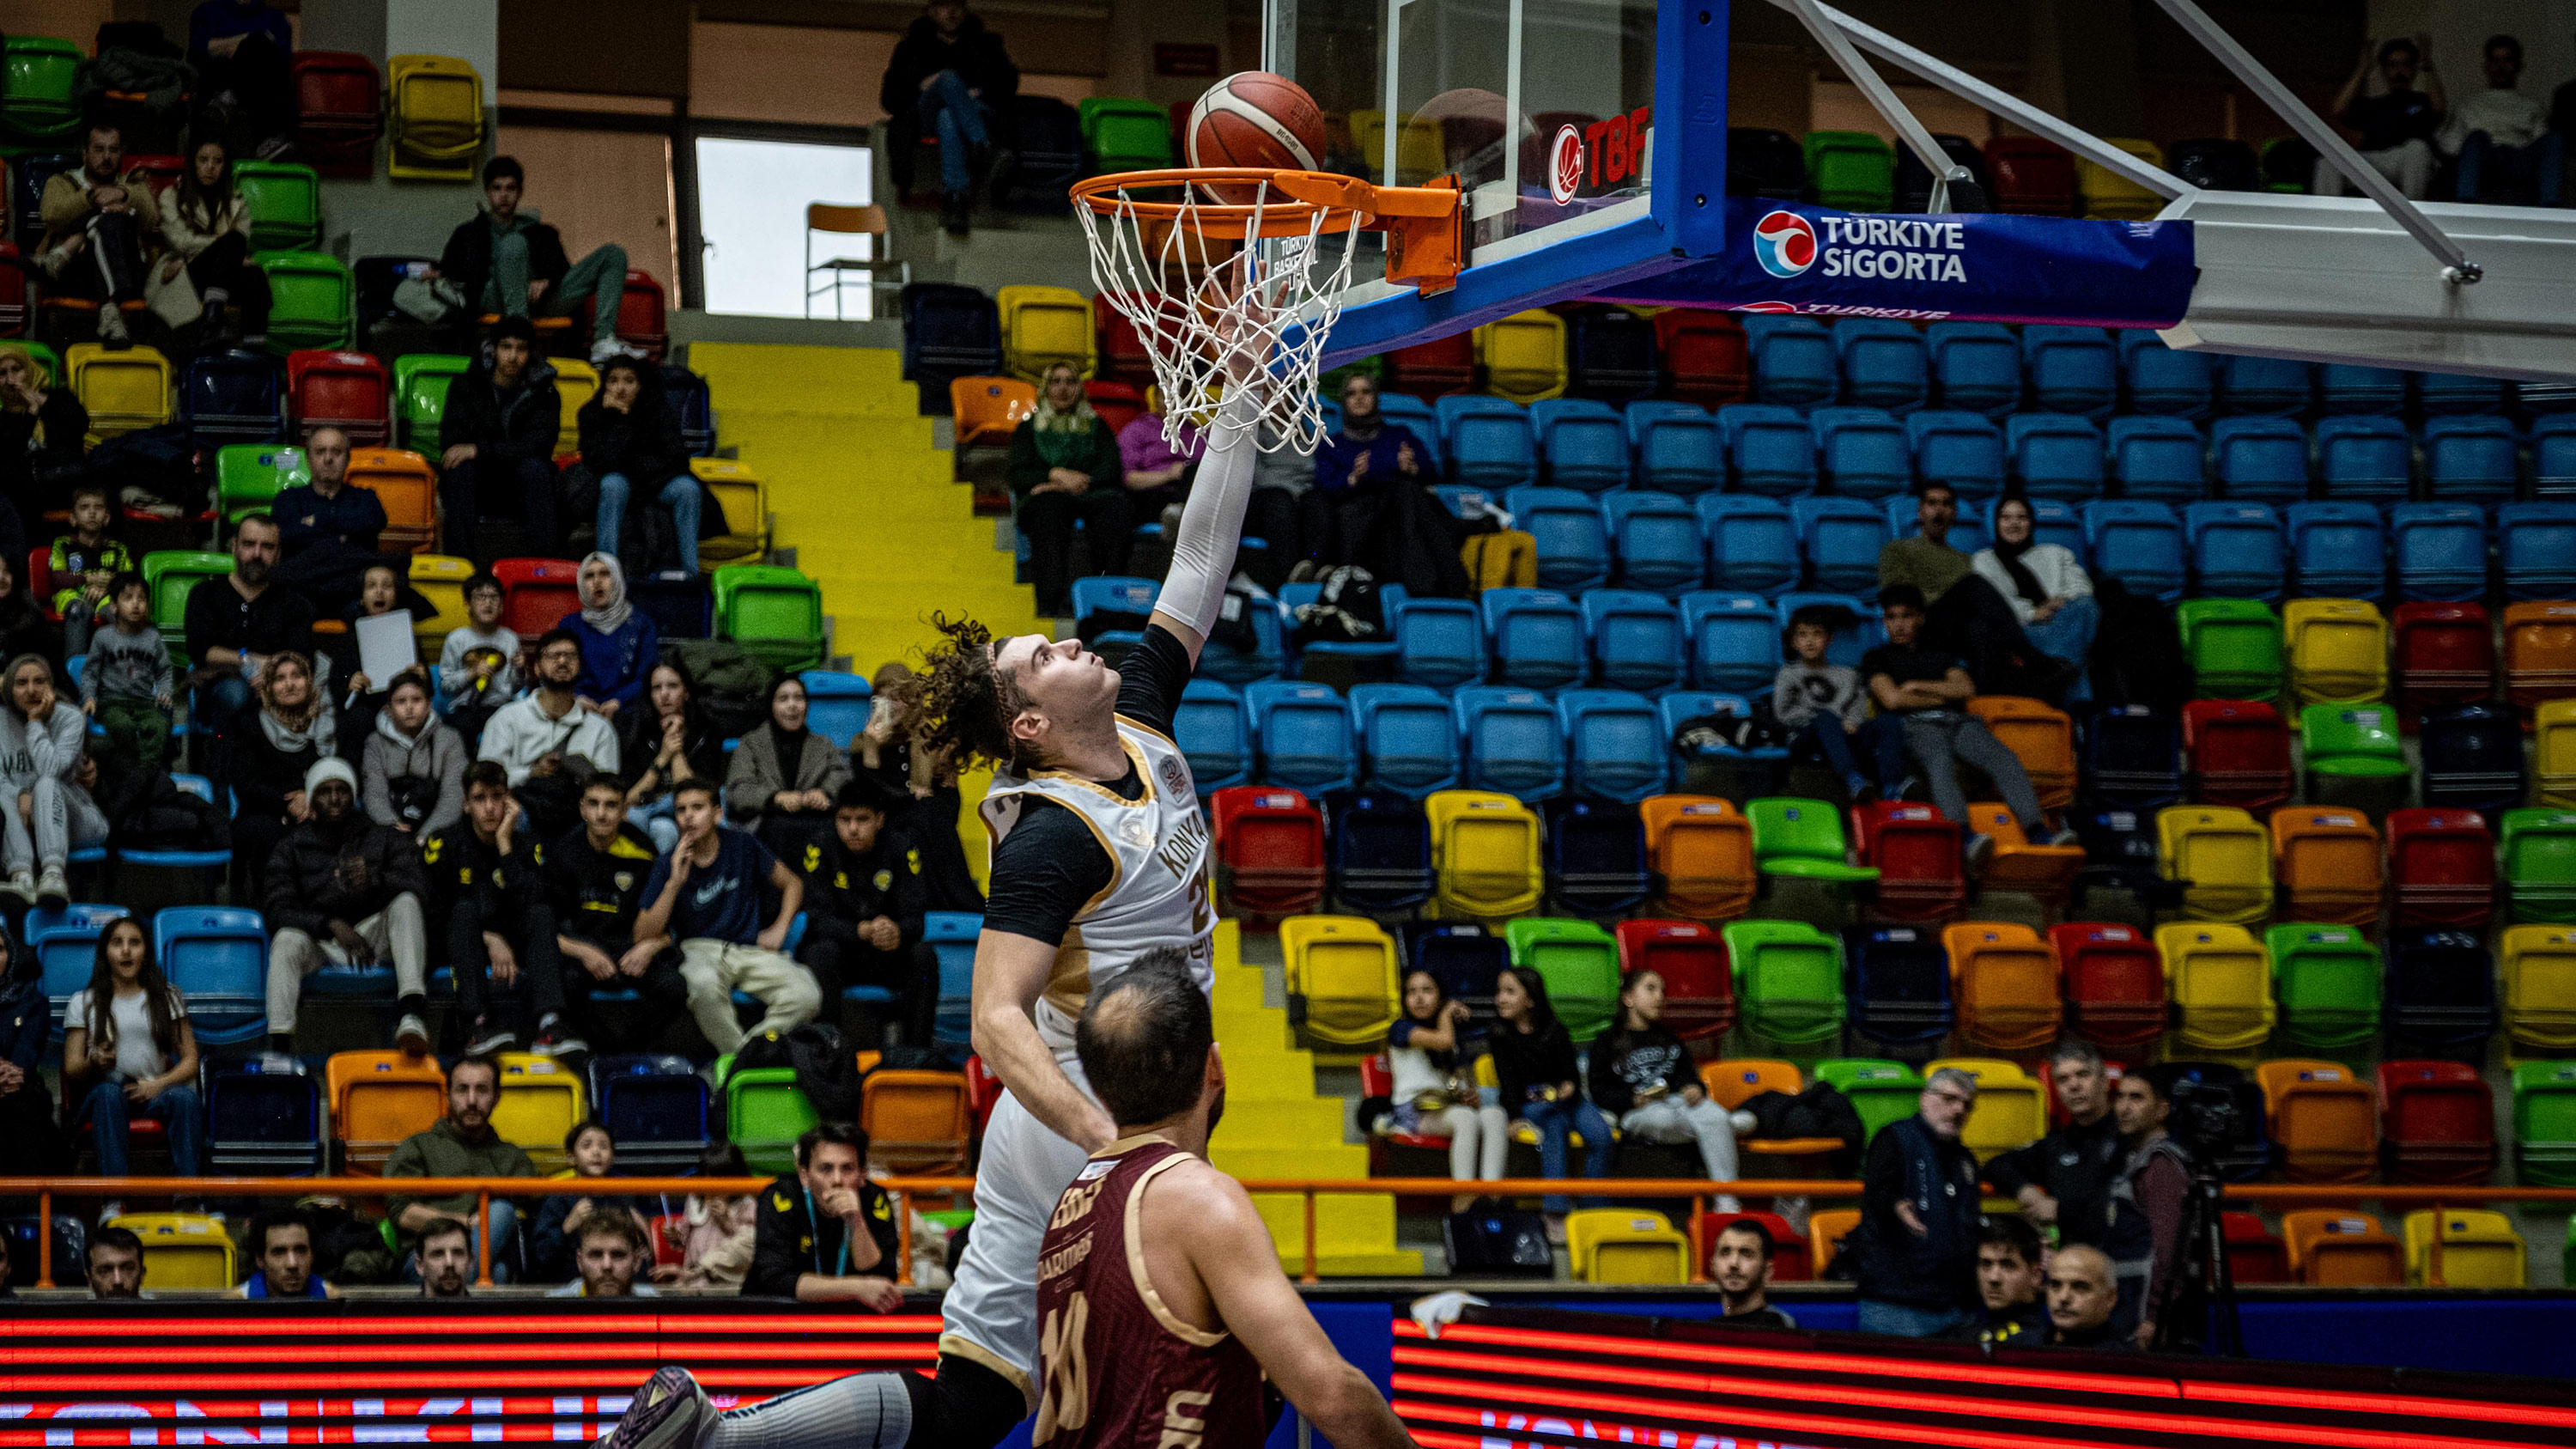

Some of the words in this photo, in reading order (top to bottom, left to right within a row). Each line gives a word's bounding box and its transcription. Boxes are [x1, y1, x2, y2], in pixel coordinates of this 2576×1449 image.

[1586, 106, 1649, 187] TBF
[1820, 216, 1965, 249] TÜRKİYE
[1822, 248, 1966, 283] SİGORTA
[1157, 810, 1208, 880] KONYA
